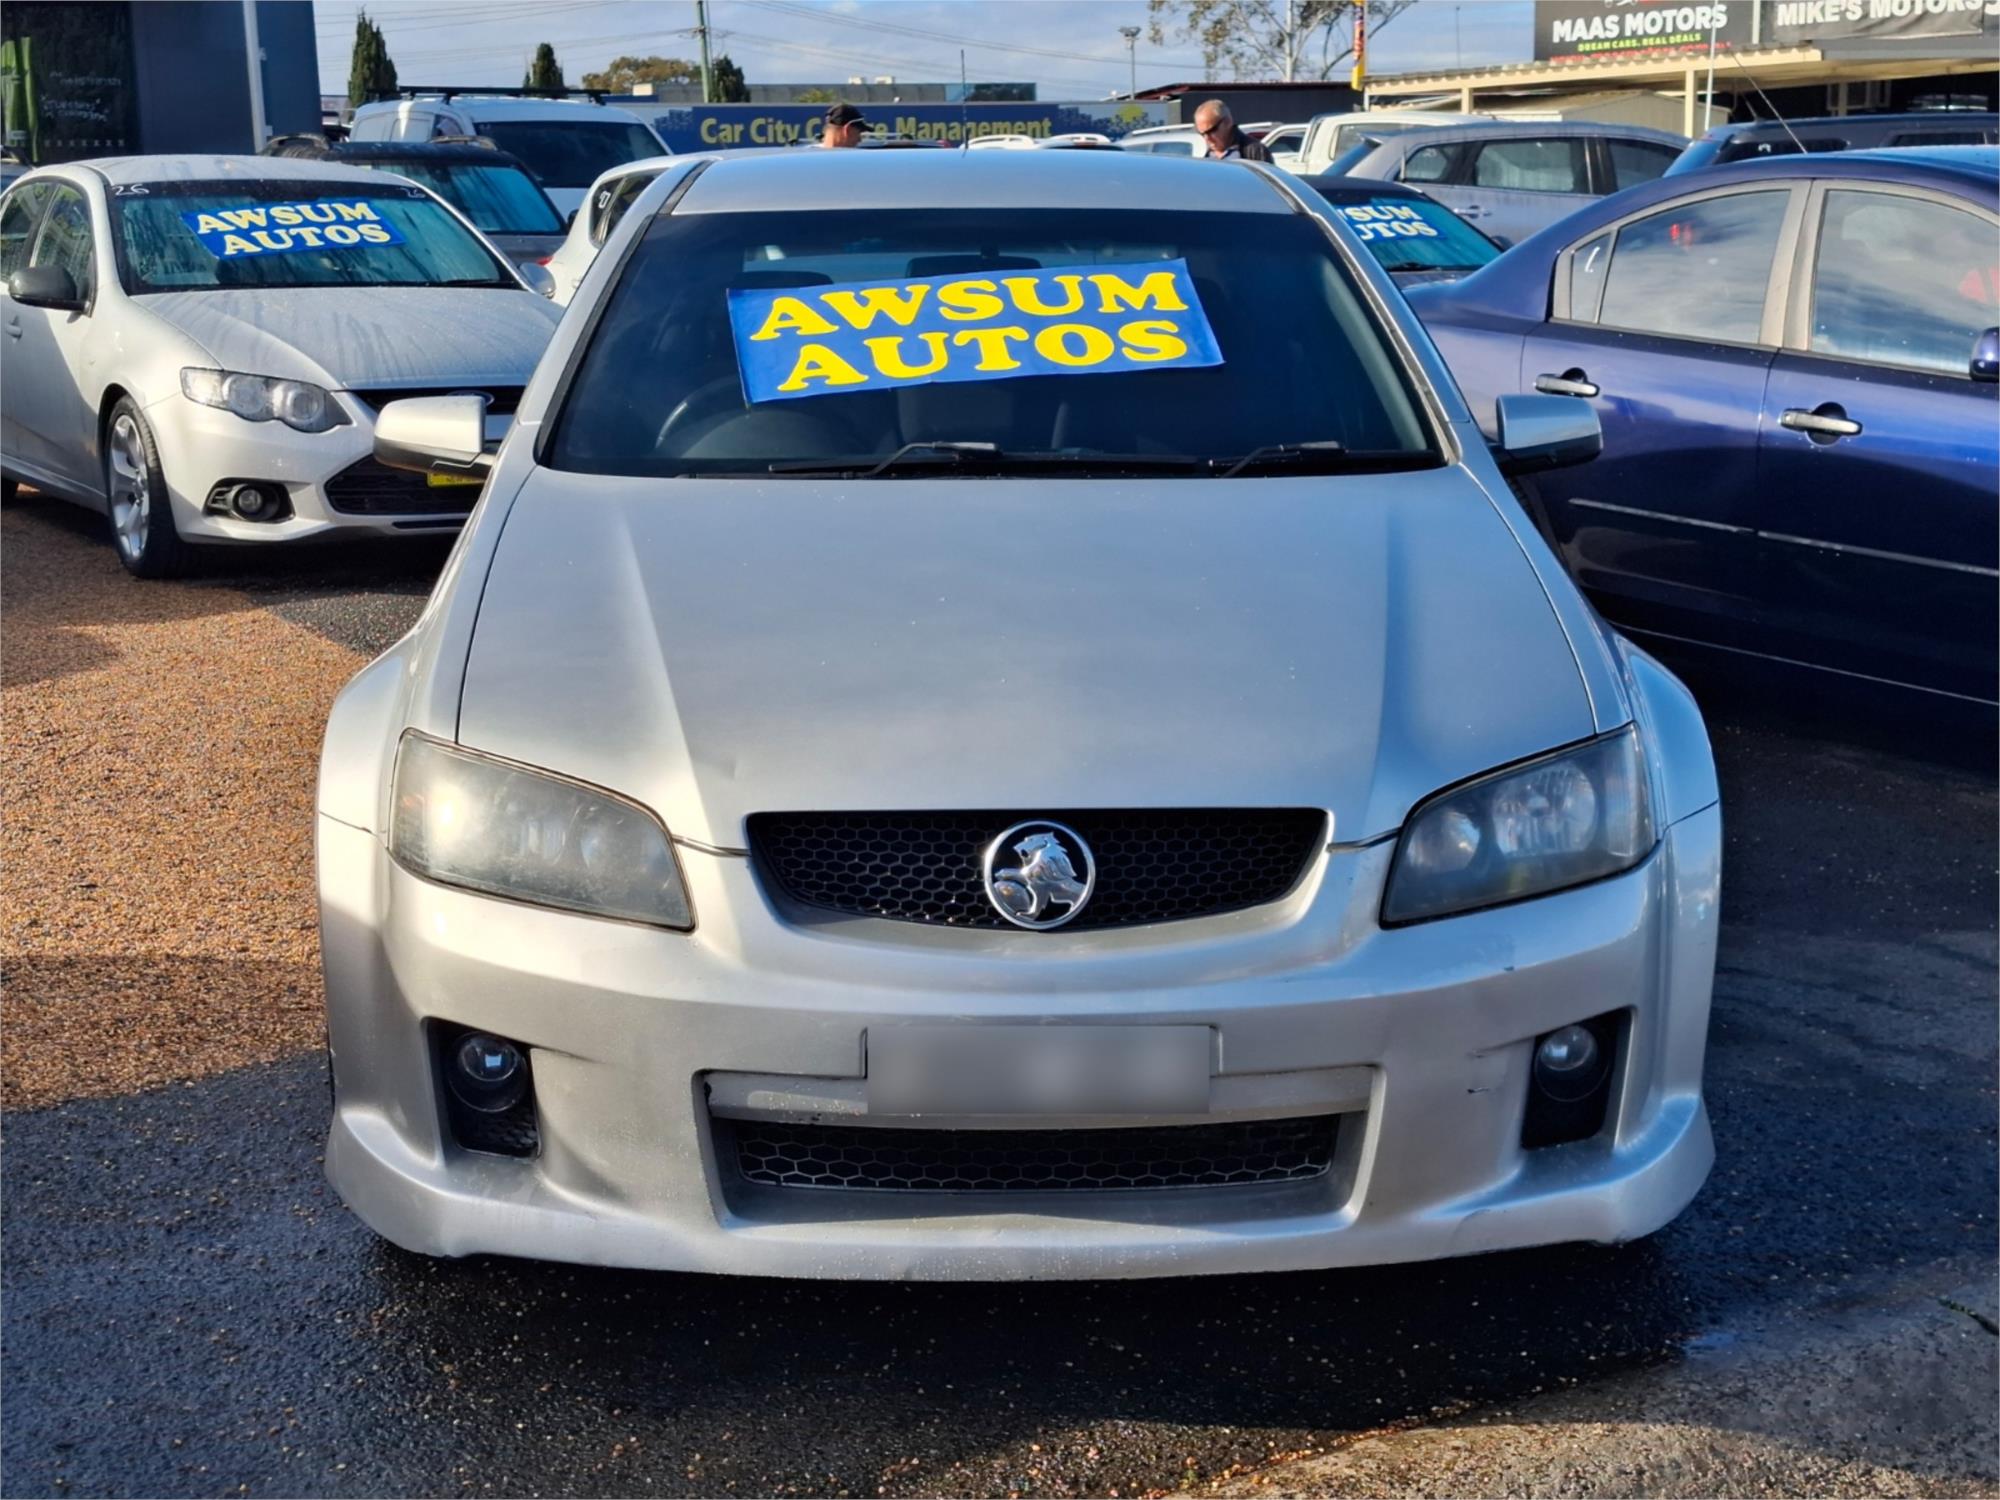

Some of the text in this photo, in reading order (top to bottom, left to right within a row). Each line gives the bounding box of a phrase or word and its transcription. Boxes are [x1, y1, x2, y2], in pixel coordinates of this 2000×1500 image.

[1552, 4, 1728, 43] MAAS MOTORS
[1776, 0, 1863, 26] MIKE'S
[1669, 33, 1702, 43] DEALS
[700, 117, 744, 144] Car
[750, 117, 800, 144] City
[197, 201, 380, 235] AWSUM
[1337, 205, 1423, 221] SUM
[224, 223, 391, 256] AUTOS
[1355, 221, 1439, 240] TOS
[749, 271, 1189, 341] AWSUM
[777, 320, 1188, 392] AUTOS
